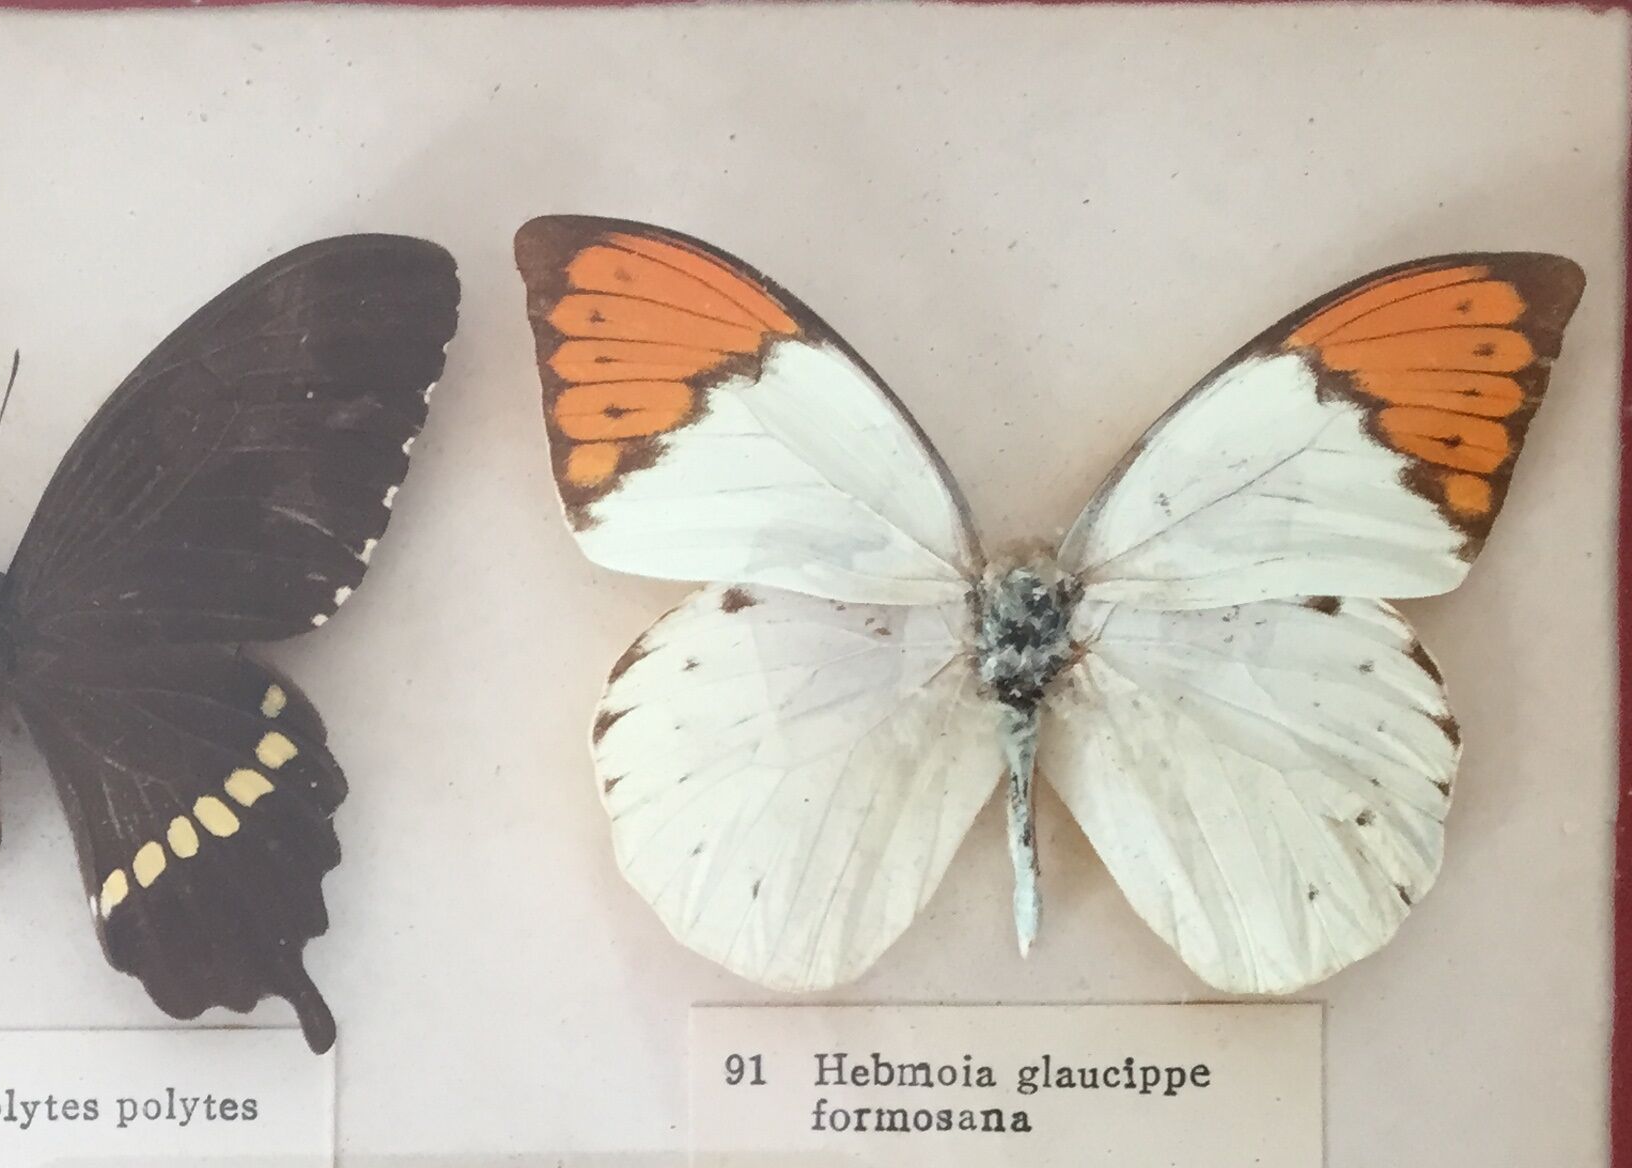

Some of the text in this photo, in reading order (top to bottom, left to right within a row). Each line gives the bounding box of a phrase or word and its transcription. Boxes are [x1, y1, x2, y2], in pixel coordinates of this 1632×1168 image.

[723, 1052, 1212, 1097] 91 Hebmoia glaucippe
[115, 1086, 259, 1129] polytes
[810, 1097, 1033, 1134] formosana
